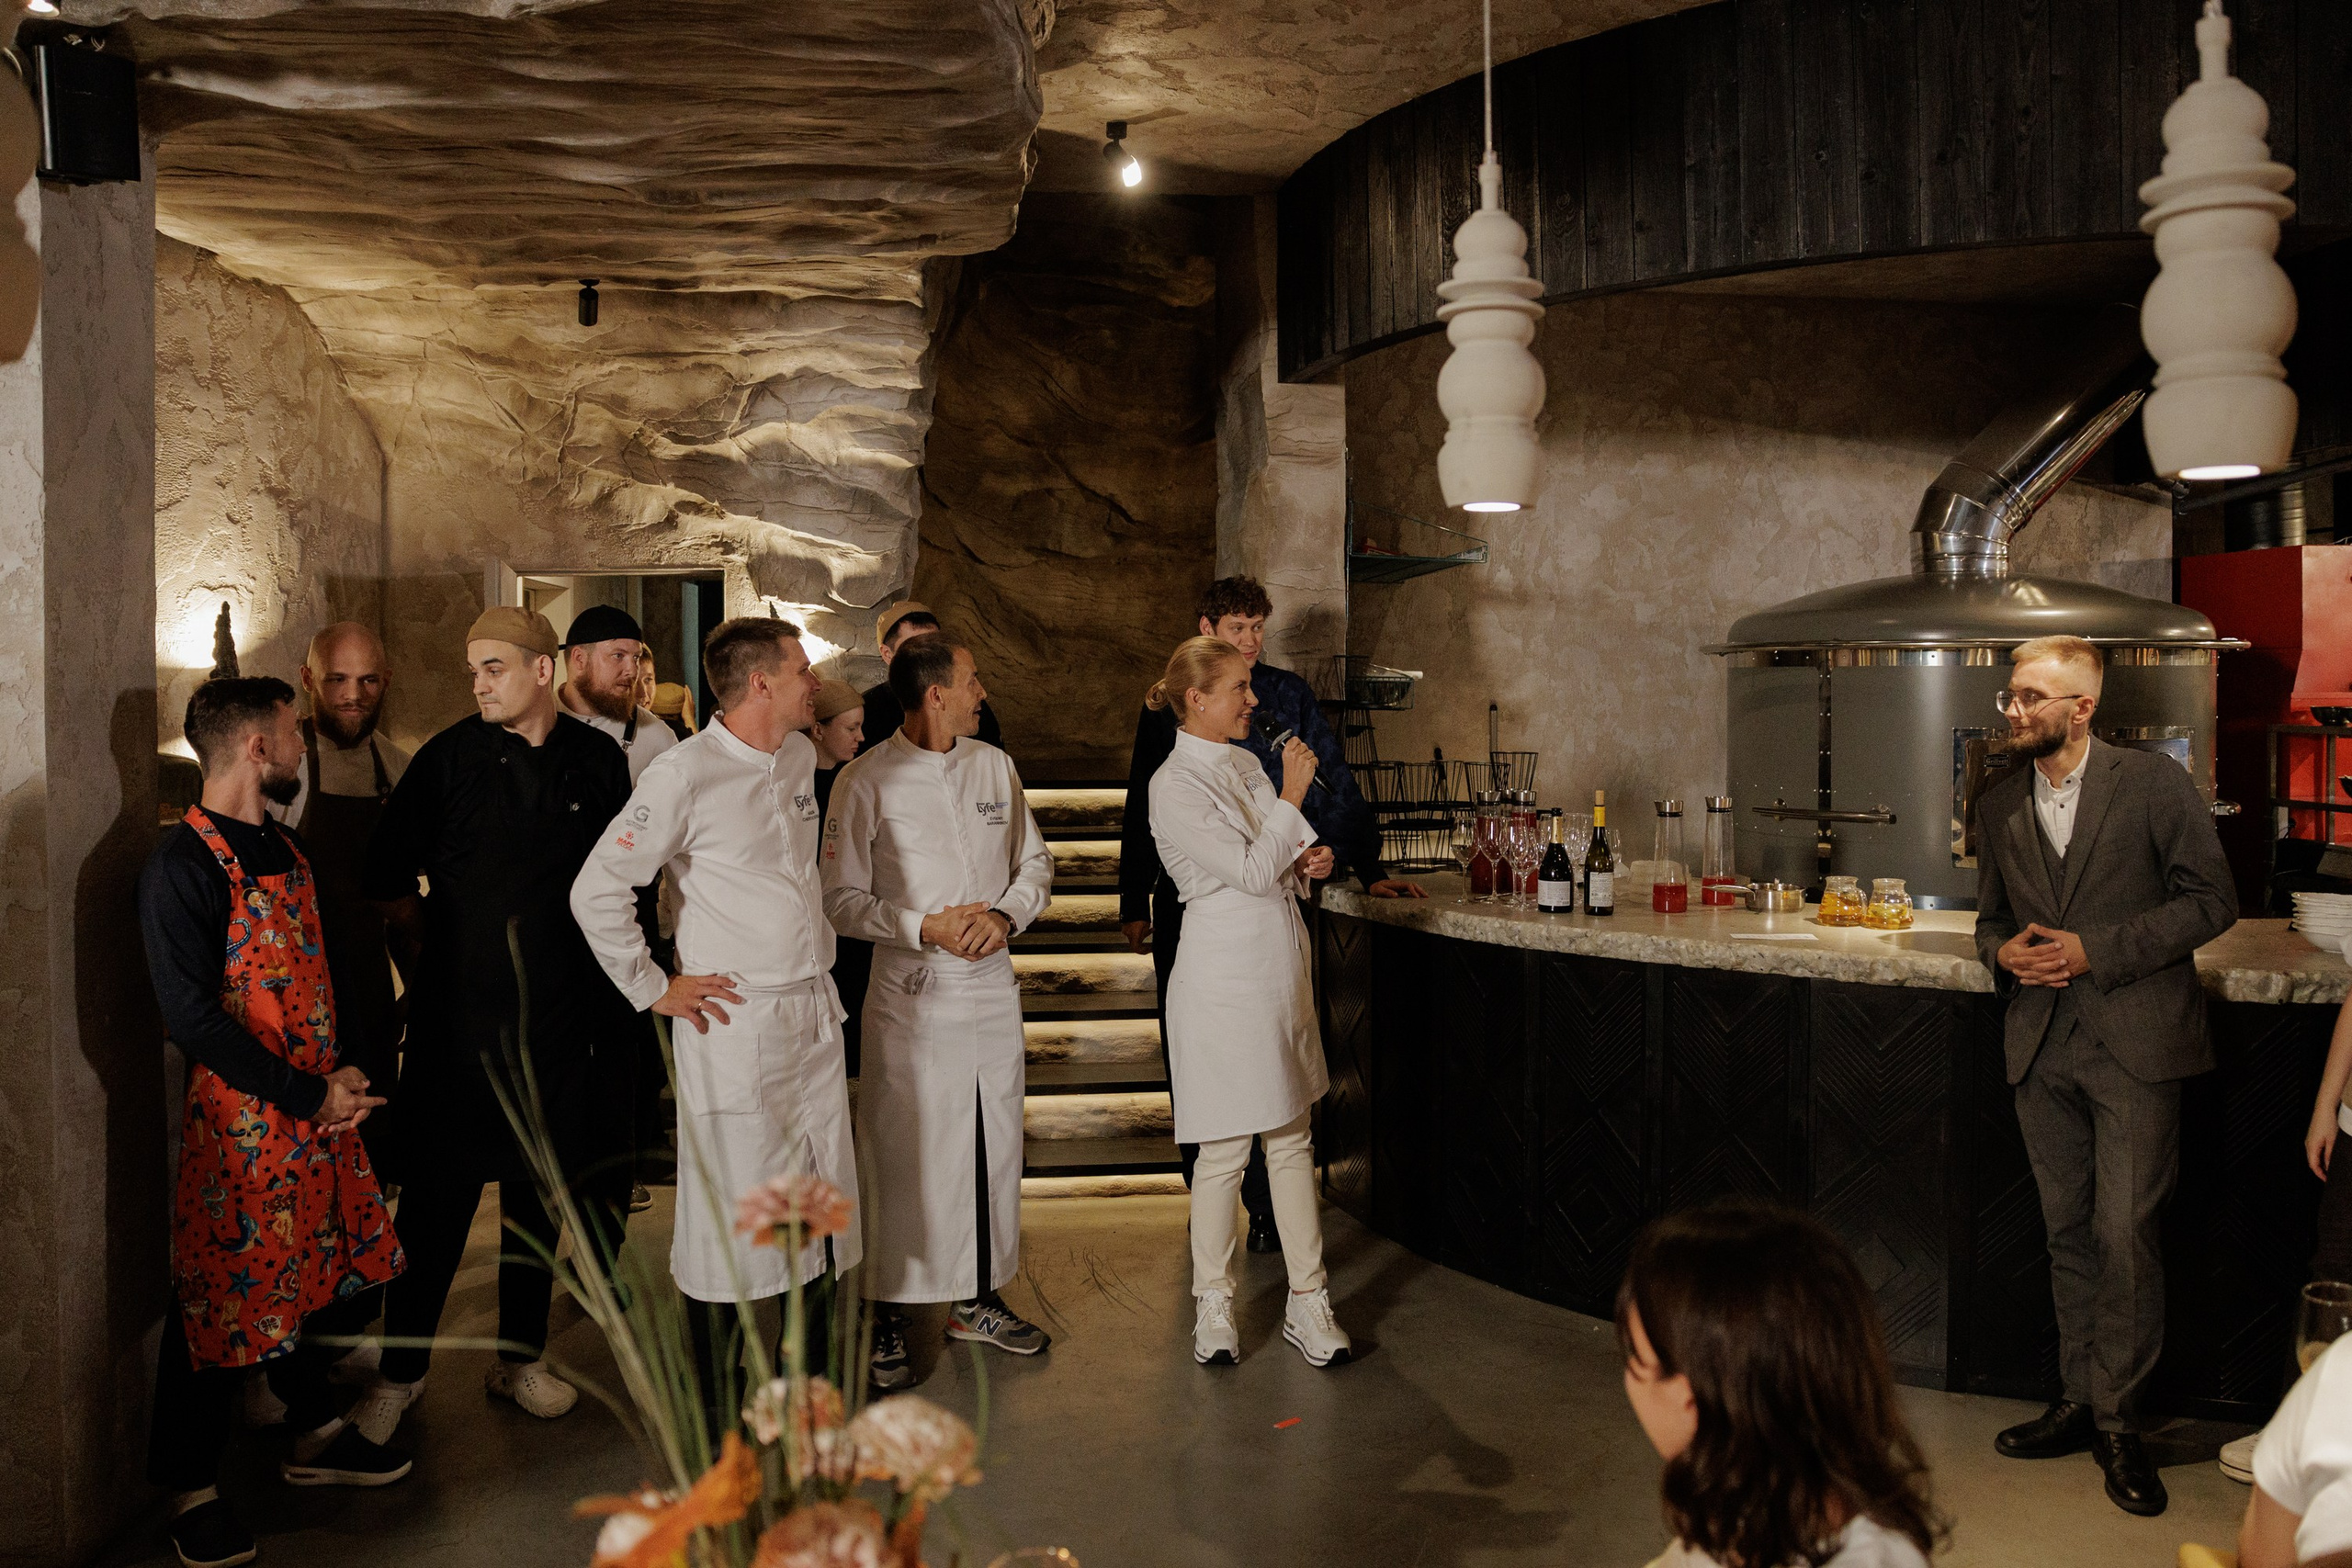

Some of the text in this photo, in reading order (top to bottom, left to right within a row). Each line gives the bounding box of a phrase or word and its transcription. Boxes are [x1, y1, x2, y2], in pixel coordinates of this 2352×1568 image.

[794, 795, 811, 812] Lyfe
[976, 802, 996, 816] Lyfe
[633, 805, 650, 823] G
[828, 818, 837, 832] G
